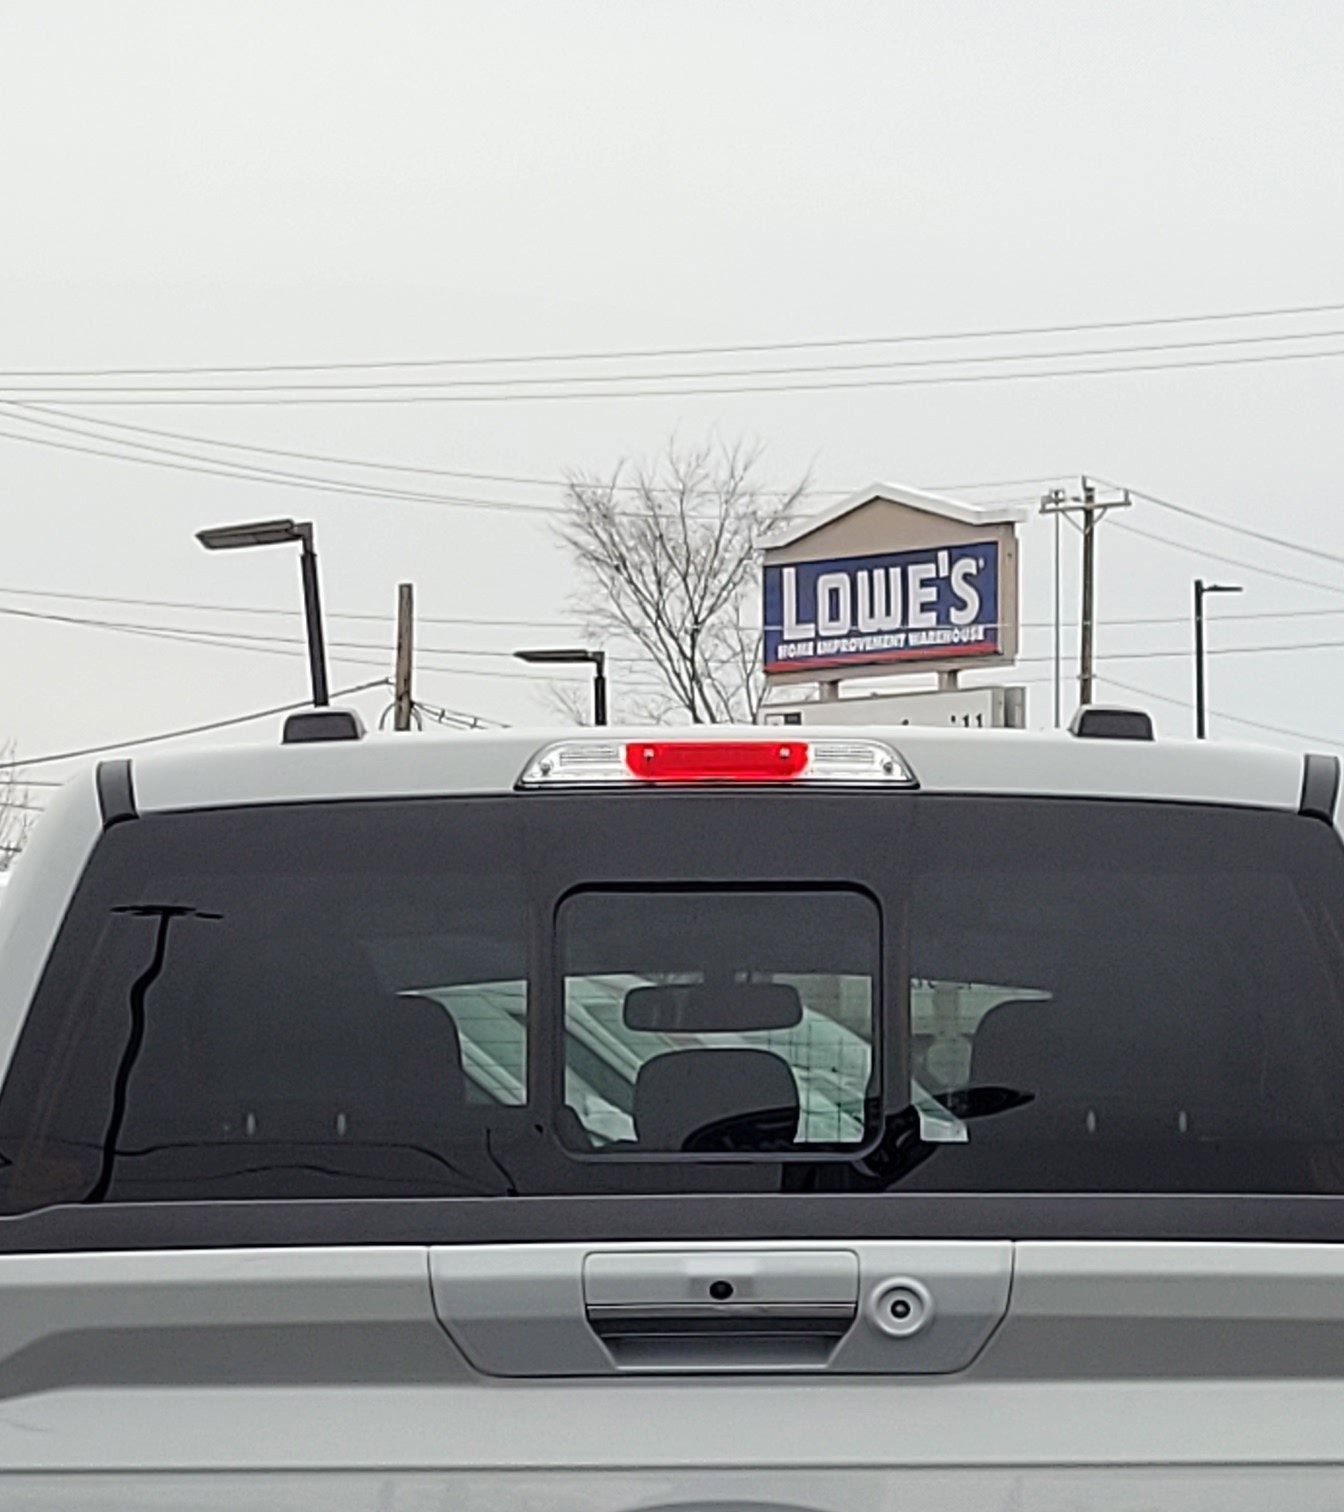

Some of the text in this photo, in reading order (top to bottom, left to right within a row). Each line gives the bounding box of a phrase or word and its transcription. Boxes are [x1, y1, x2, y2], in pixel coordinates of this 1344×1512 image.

[781, 549, 981, 640] LOWE'S
[777, 624, 985, 660] HOME IMPROVEMENT WAREHOUSE
